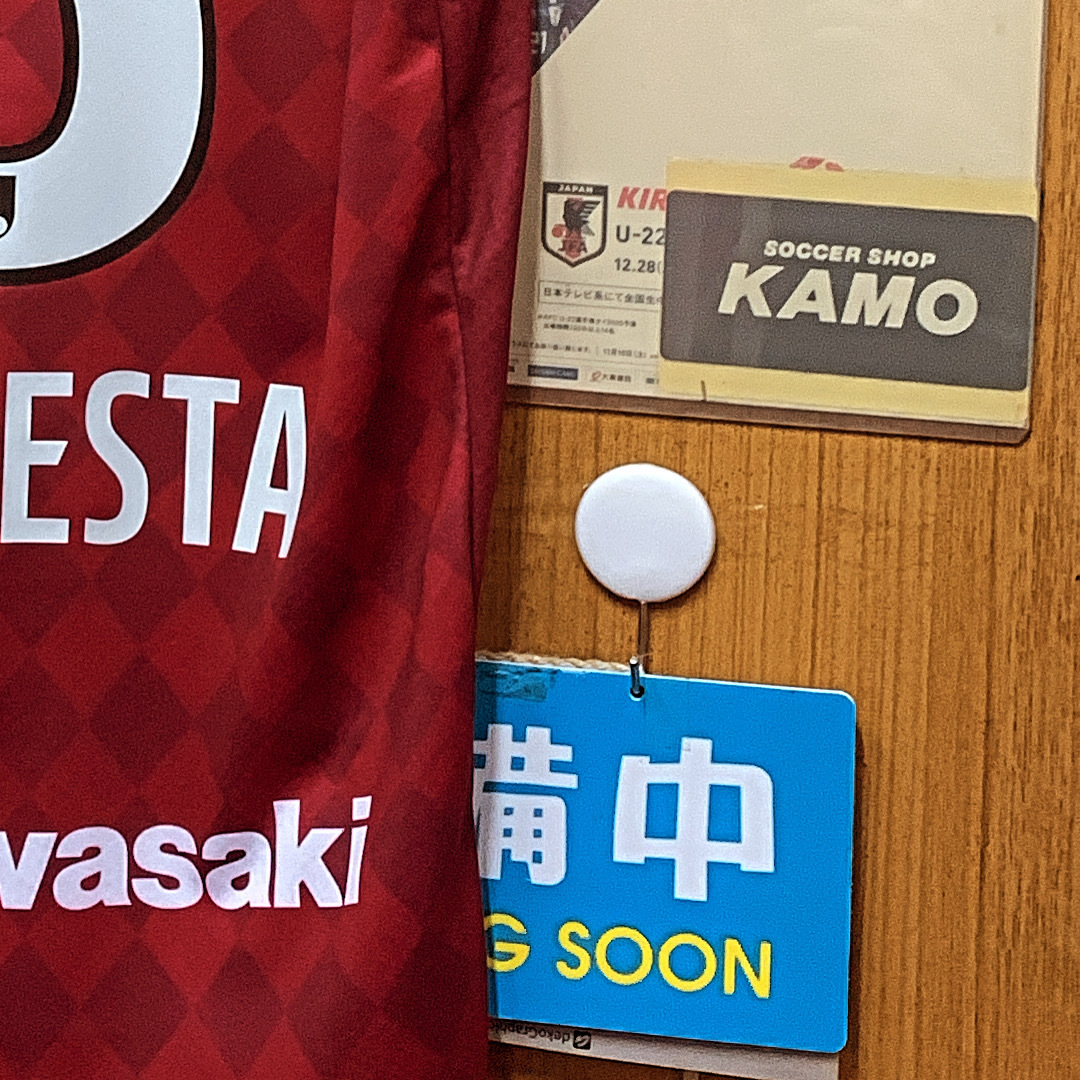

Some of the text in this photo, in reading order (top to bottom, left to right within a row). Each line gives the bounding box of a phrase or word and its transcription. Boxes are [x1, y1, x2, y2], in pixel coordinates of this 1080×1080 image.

[557, 183, 595, 194] JAPAN
[763, 239, 937, 270] SOCCER SHOP
[717, 262, 979, 337] KAMO
[555, 920, 772, 1000] SOON
